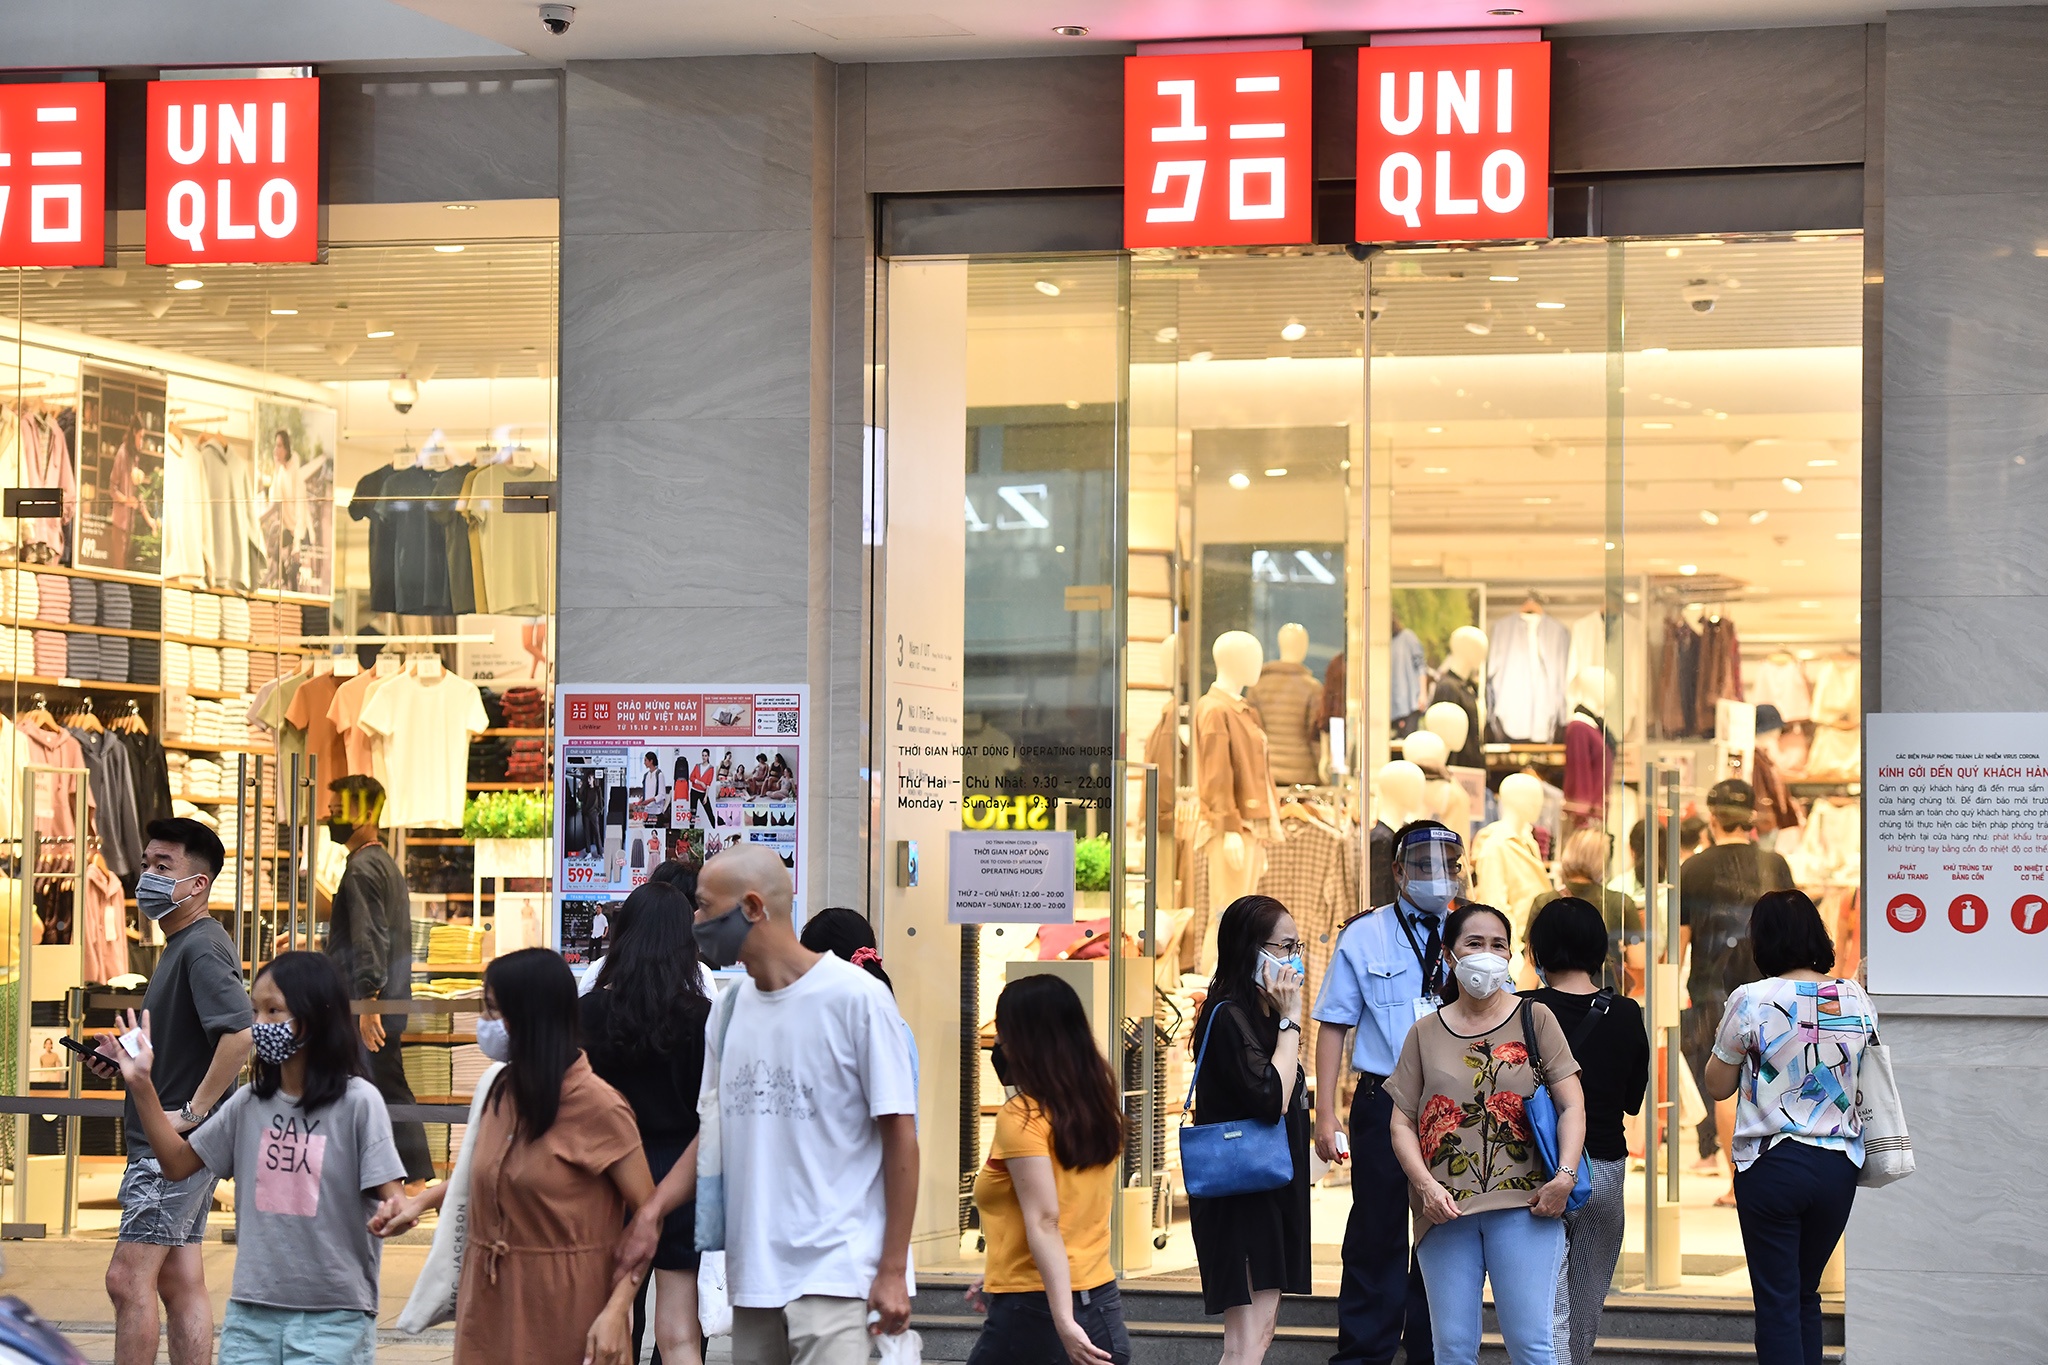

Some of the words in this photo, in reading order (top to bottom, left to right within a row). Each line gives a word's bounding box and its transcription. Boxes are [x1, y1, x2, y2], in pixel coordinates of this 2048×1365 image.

[1379, 69, 1513, 135] UNI
[0, 107, 82, 167] ニ
[168, 102, 286, 165] UNI
[1379, 149, 1525, 228] QLO
[0, 184, 82, 242] ロ
[167, 178, 298, 251] QLO
[897, 634, 904, 667] 3
[594, 703, 608, 711] UNI
[617, 700, 640, 710] CHÀO
[645, 700, 670, 710] MỪNG
[674, 700, 697, 710] NGÀY
[594, 711, 609, 719] QLO
[617, 712, 634, 722] PHỤ
[638, 711, 651, 721] NỮ
[654, 711, 674, 722] VIỆT
[677, 712, 696, 721] NAM
[897, 697, 904, 731] 2
[899, 743, 920, 756] THỜI
[925, 746, 948, 756] GIAN
[952, 746, 978, 758] HOẠT
[982, 743, 1009, 757] ĐỘNG
[1020, 746, 1075, 756] OPERATING
[1080, 746, 1112, 756] HOURS
[1878, 765, 1904, 778] KÍNH
[1930, 764, 1952, 778] ĐẾN
[1957, 765, 1979, 779] QUÝ
[1983, 765, 2021, 778] KHÁCH
[2026, 765, 2048, 778] HÀN
[899, 776, 921, 788] Thứ
[926, 776, 946, 788] Hai
[966, 776, 989, 788] Chủ
[1033, 776, 1058, 788] 9:30
[1078, 776, 1111, 788] 22:00
[898, 797, 943, 812] Monday
[1033, 797, 1058, 808] 9:30
[1078, 797, 1111, 808] 22:00
[676, 812, 691, 821] 599
[1009, 849, 1027, 857] HOẠT
[1028, 848, 1049, 857] ĐỘNG
[568, 868, 593, 882] 599
[984, 889, 998, 897] CHỦ
[1000, 889, 1020, 898] NHẬT:
[270, 1113, 320, 1145] SAY
[453, 1204, 466, 1273] JACKSON
